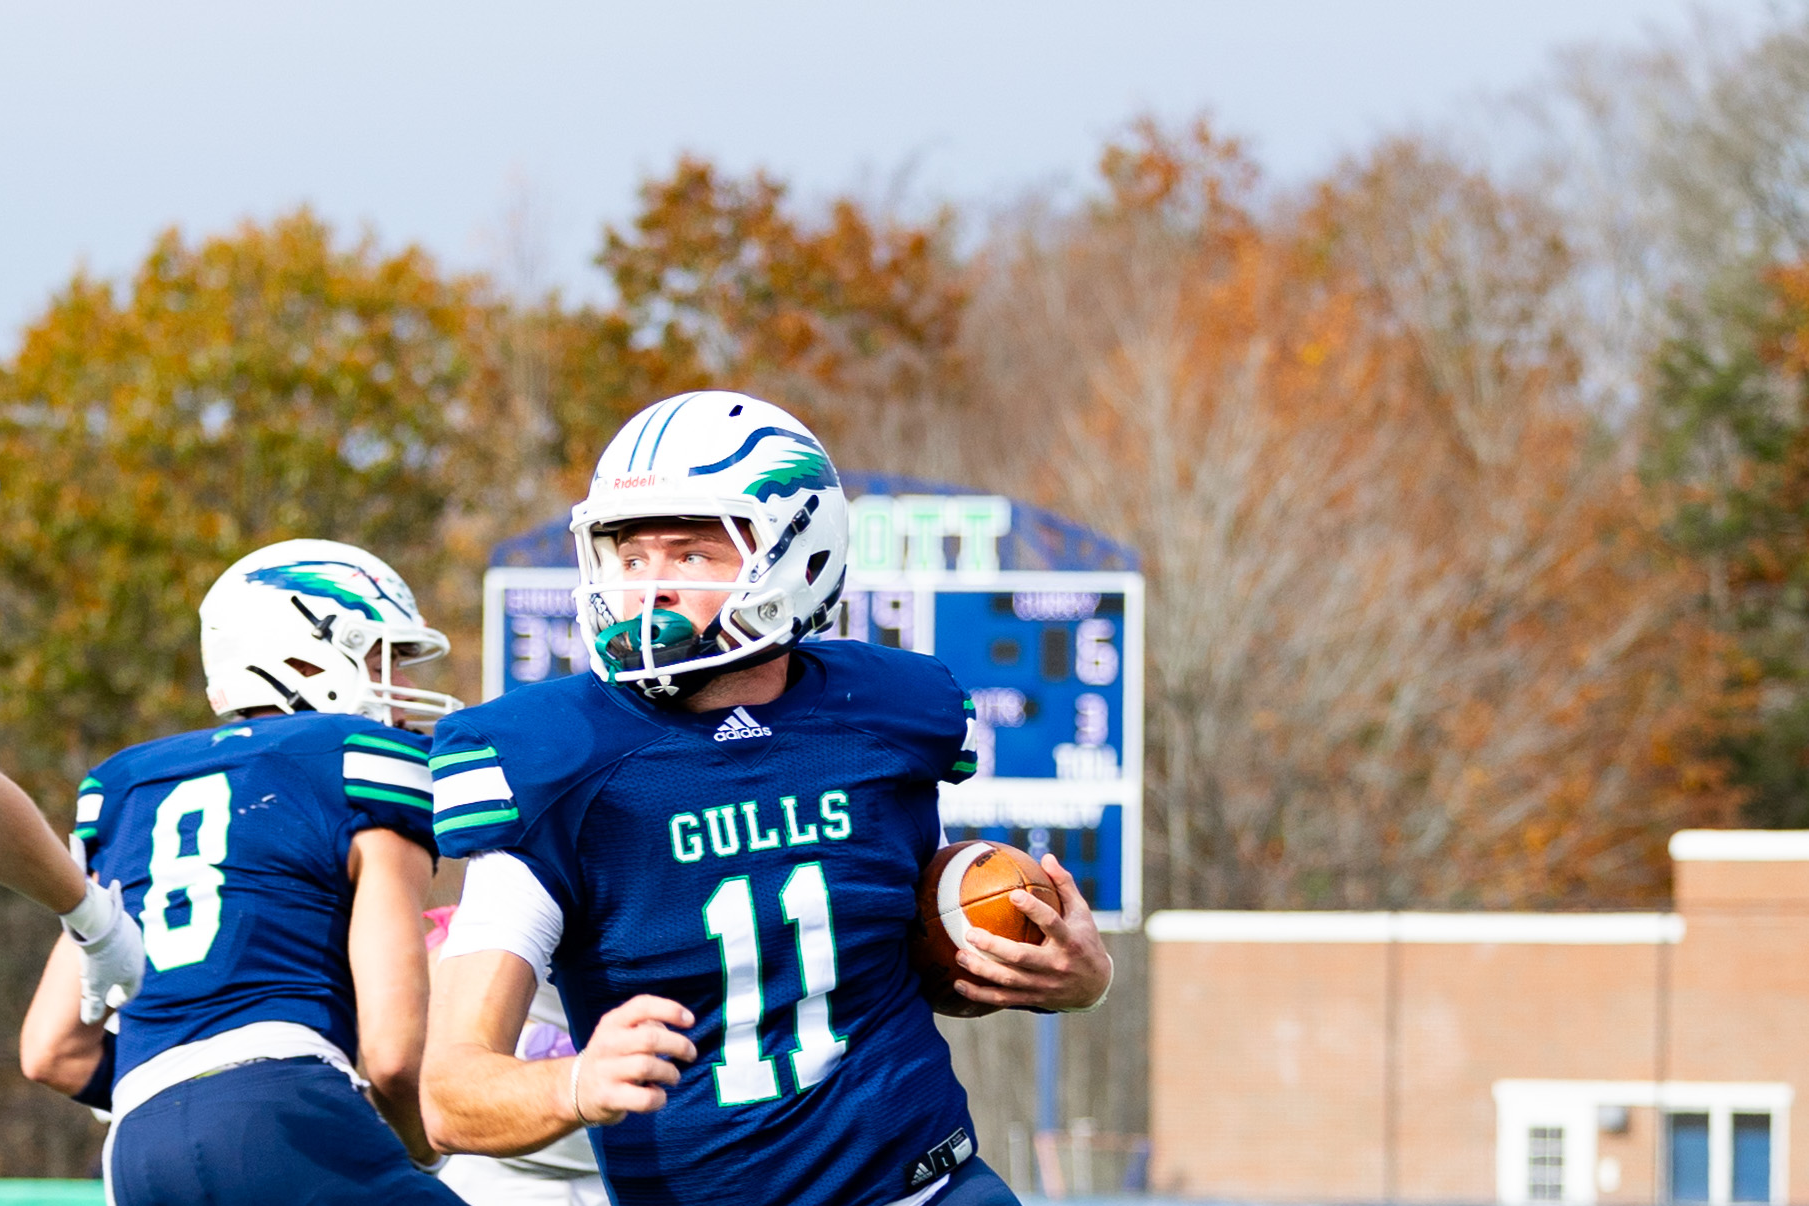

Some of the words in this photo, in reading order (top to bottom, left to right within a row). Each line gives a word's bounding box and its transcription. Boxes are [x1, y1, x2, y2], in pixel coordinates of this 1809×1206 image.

[613, 475, 656, 490] Riddell
[1076, 619, 1119, 685] 6
[713, 726, 773, 742] adidas
[668, 789, 852, 864] GULLS
[140, 772, 232, 973] 8
[701, 861, 848, 1108] 11
